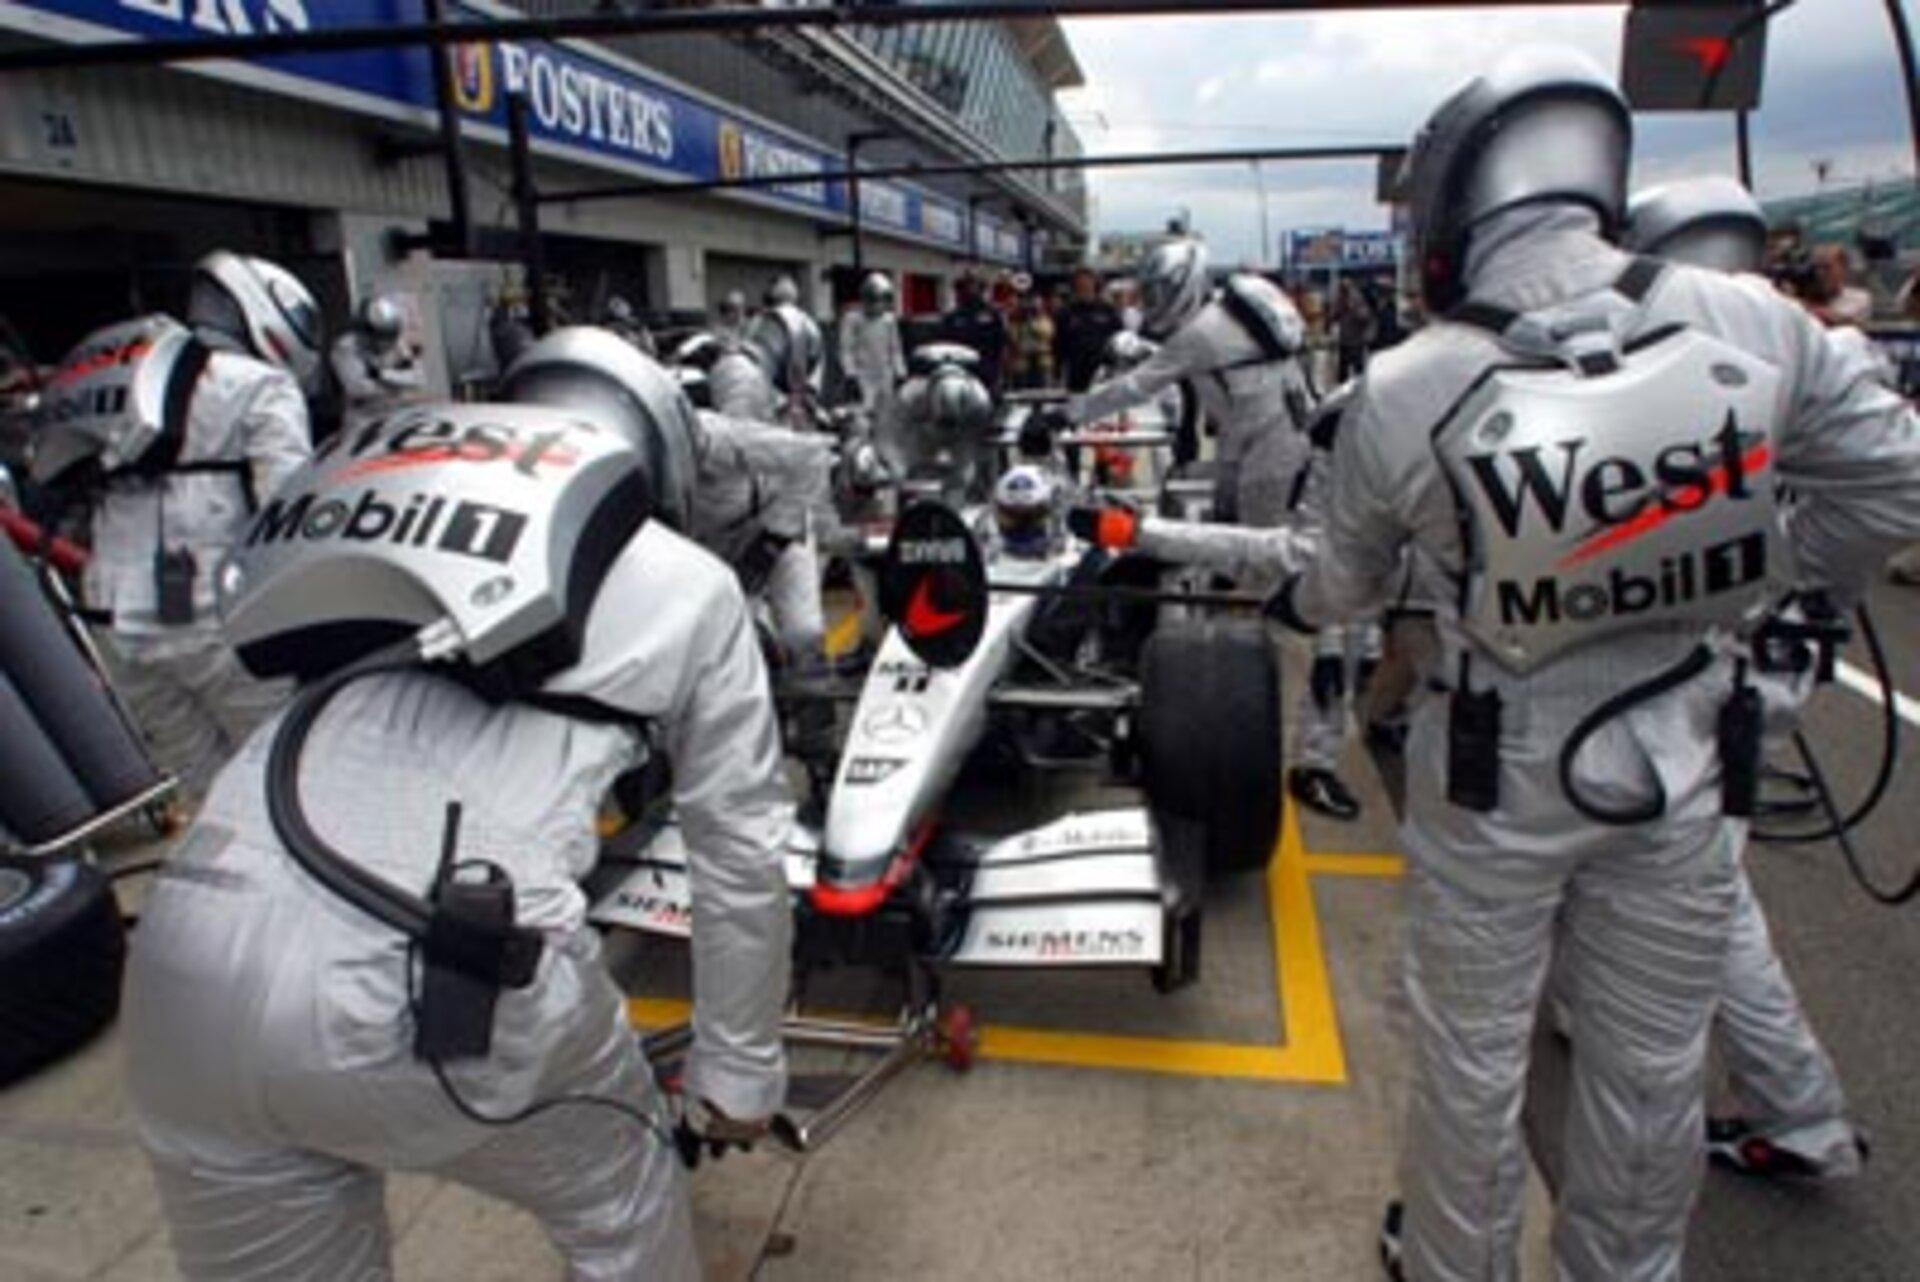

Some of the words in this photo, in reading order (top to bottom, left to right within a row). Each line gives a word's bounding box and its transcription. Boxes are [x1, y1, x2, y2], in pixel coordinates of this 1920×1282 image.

[1468, 407, 1766, 537] West
[247, 489, 446, 547] Mobil
[1497, 553, 1697, 624] Mobil
